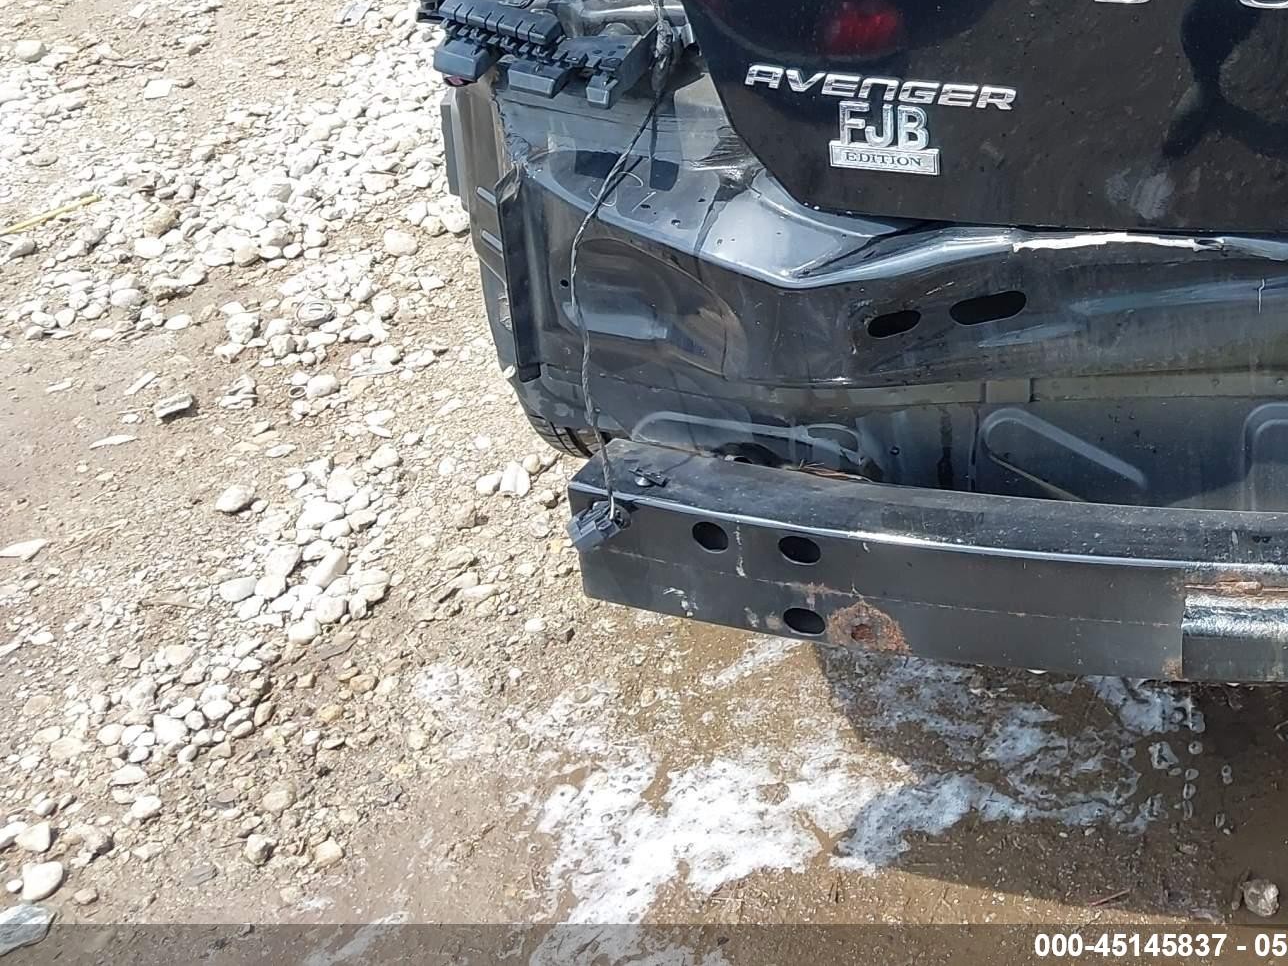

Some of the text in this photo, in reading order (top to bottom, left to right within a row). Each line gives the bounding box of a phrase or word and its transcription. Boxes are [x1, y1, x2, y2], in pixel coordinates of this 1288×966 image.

[744, 64, 1017, 111] AVENGER
[837, 100, 930, 151] FJB
[843, 151, 923, 168] EDITION
